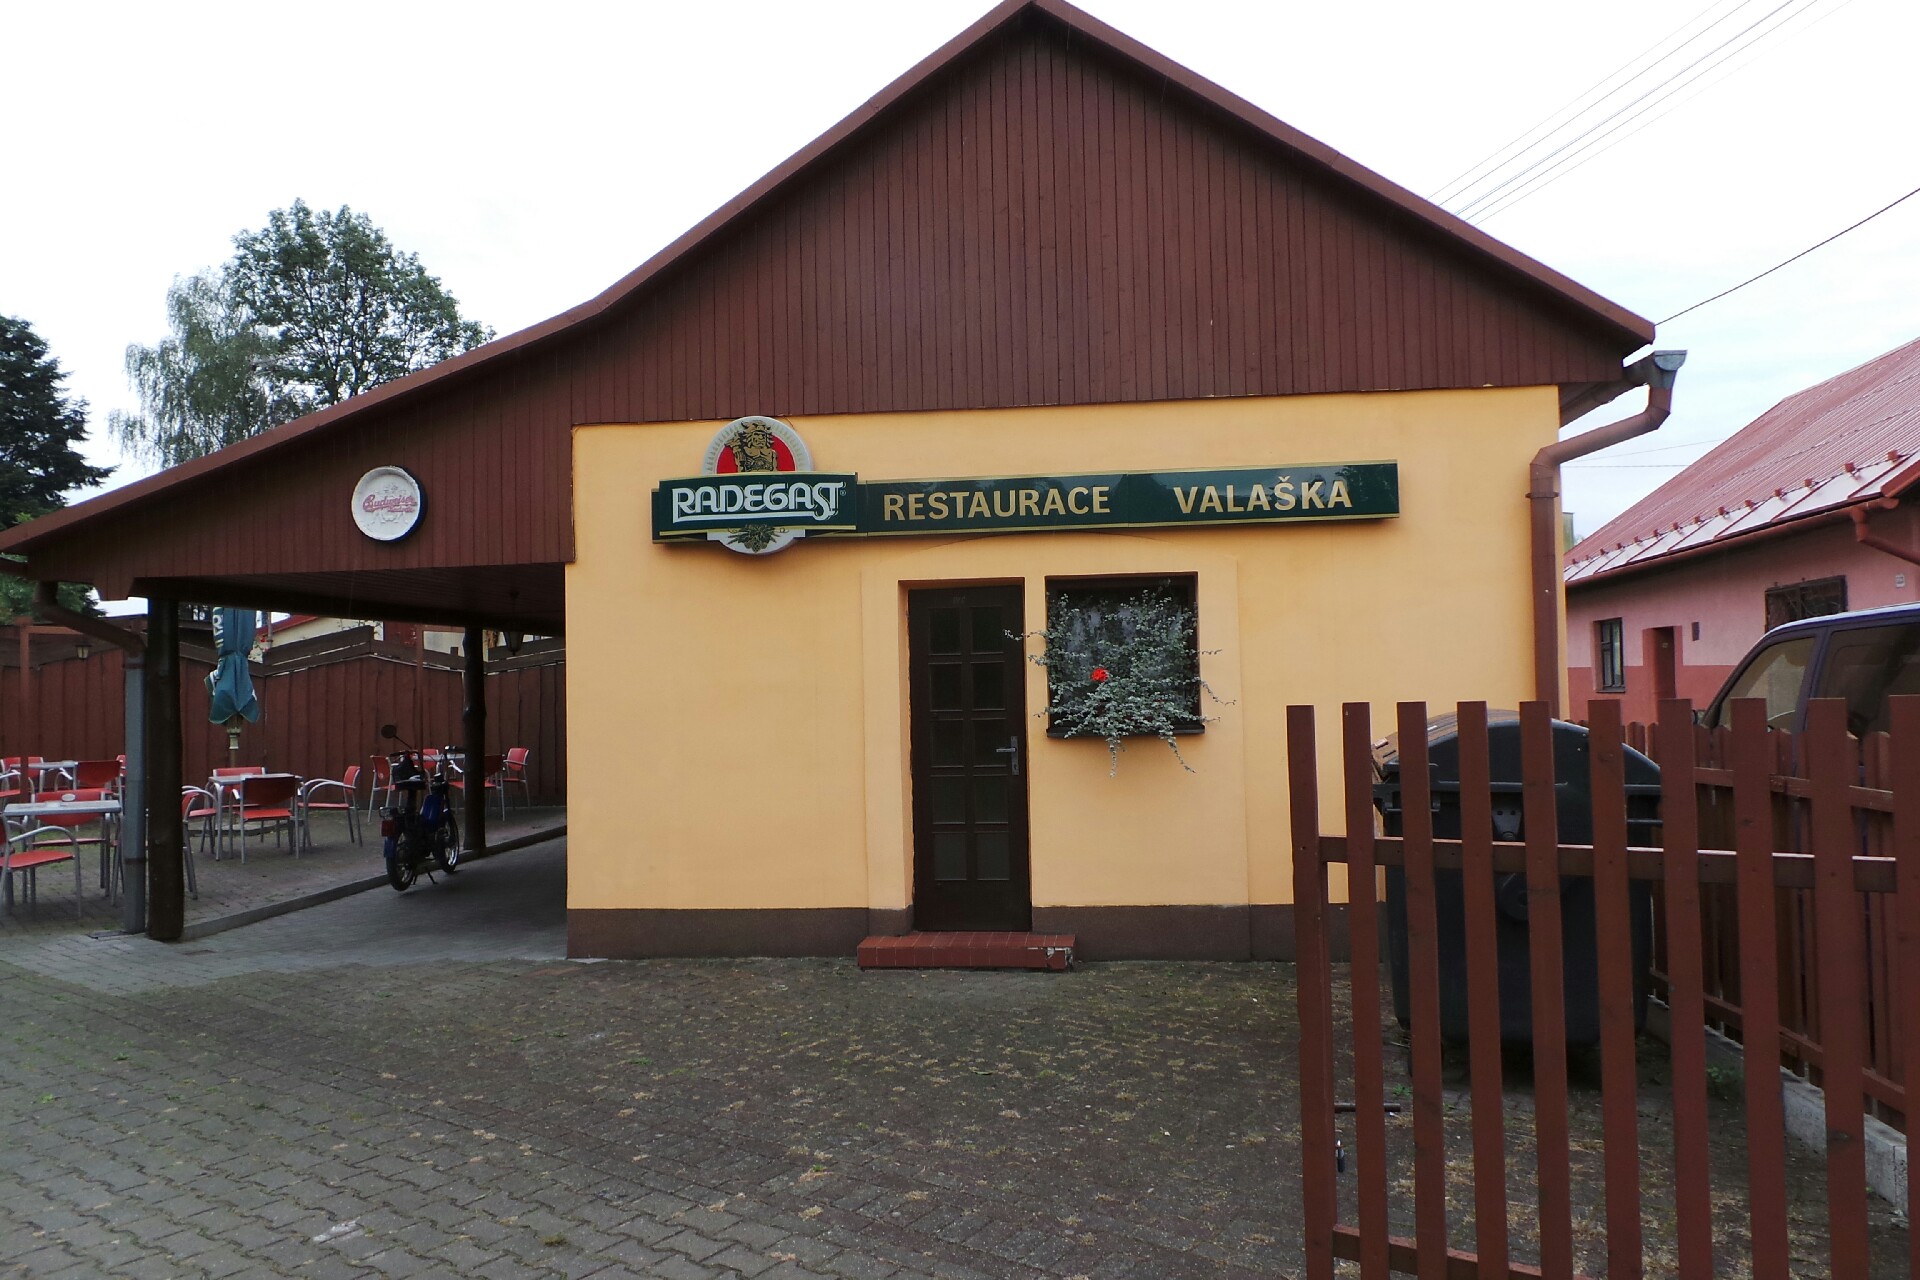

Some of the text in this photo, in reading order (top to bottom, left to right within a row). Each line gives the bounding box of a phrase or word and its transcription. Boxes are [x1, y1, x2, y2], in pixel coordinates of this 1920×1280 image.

[672, 481, 847, 524] RADEGAST
[883, 475, 1353, 521] RESTAURACE VALAŠKA
